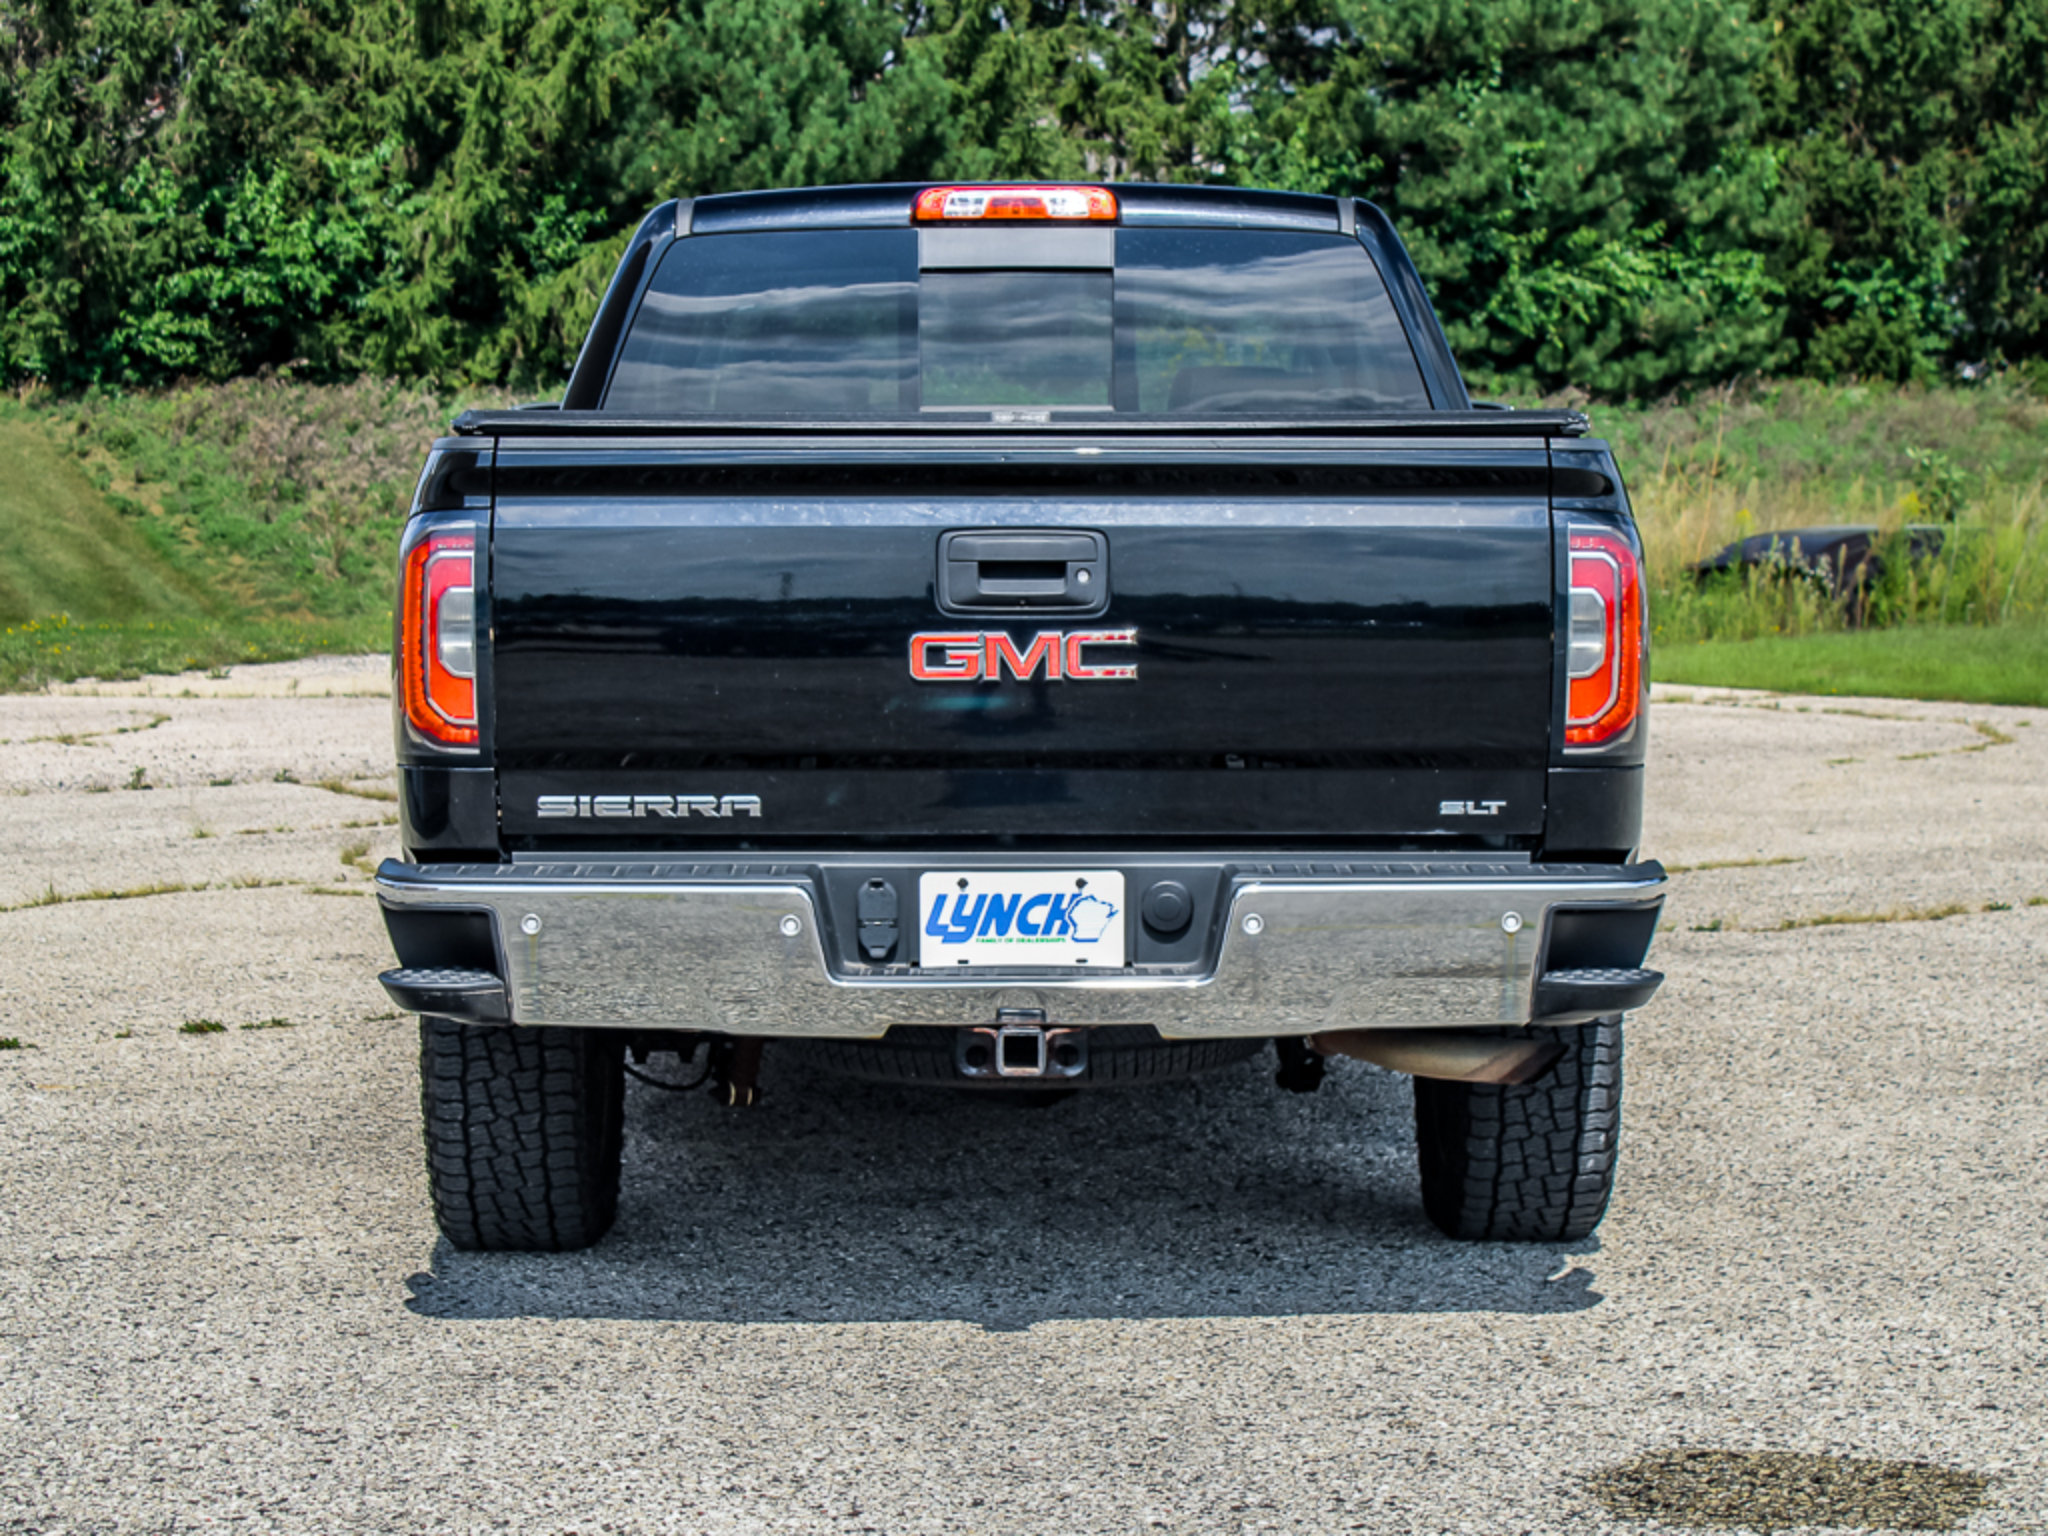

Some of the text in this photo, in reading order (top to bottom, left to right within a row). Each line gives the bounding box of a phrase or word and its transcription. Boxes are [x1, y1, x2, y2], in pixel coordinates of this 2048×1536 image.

[908, 629, 1138, 682] GMC
[536, 794, 763, 819] SIERRA
[1440, 800, 1507, 815] SLT
[925, 893, 1083, 944] LYNCH
